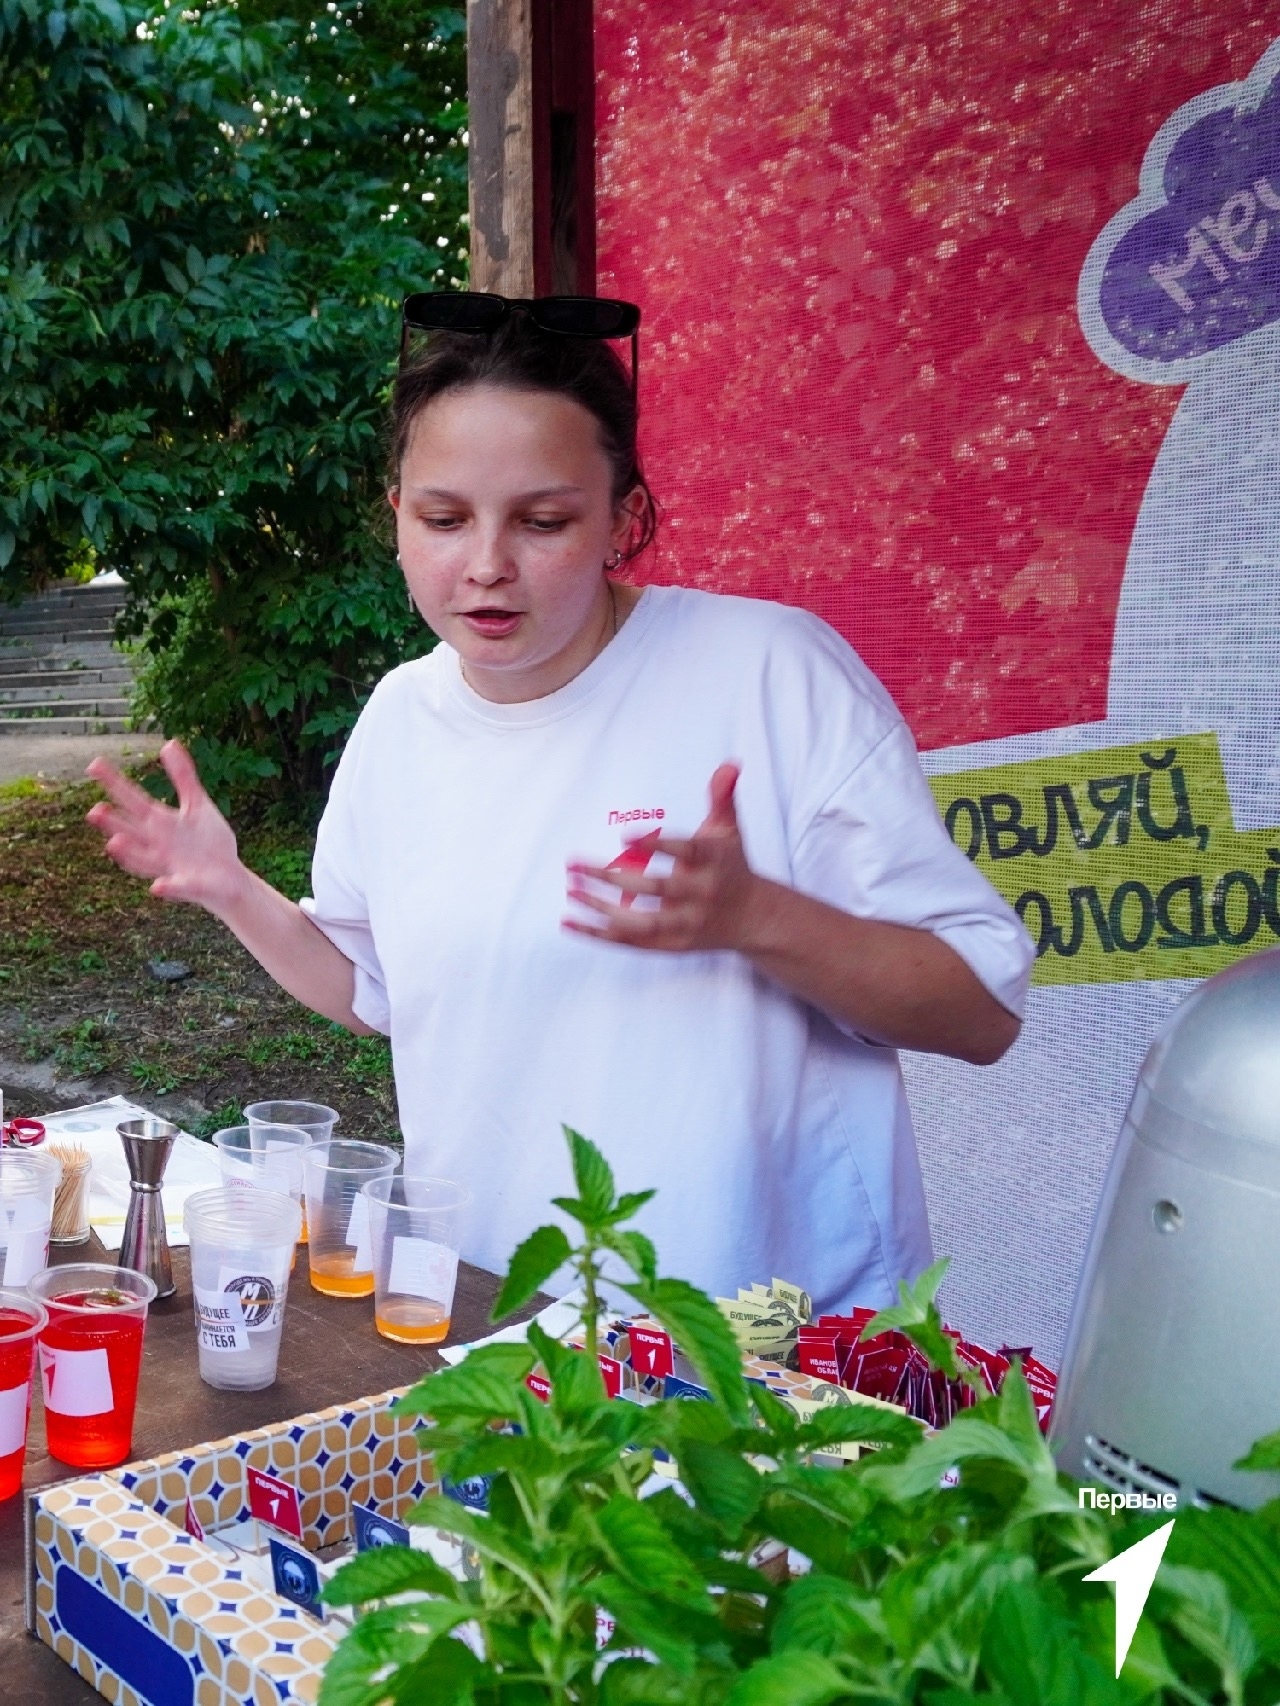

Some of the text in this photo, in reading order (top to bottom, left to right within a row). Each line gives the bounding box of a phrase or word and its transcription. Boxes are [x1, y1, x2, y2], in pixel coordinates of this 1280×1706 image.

[607, 807, 665, 826] Первые
[1015, 848, 1280, 957] ОЛОДО
[209, 1333, 236, 1347] ТЕБЯ
[636, 1333, 665, 1345] ПЕРВЫЕ
